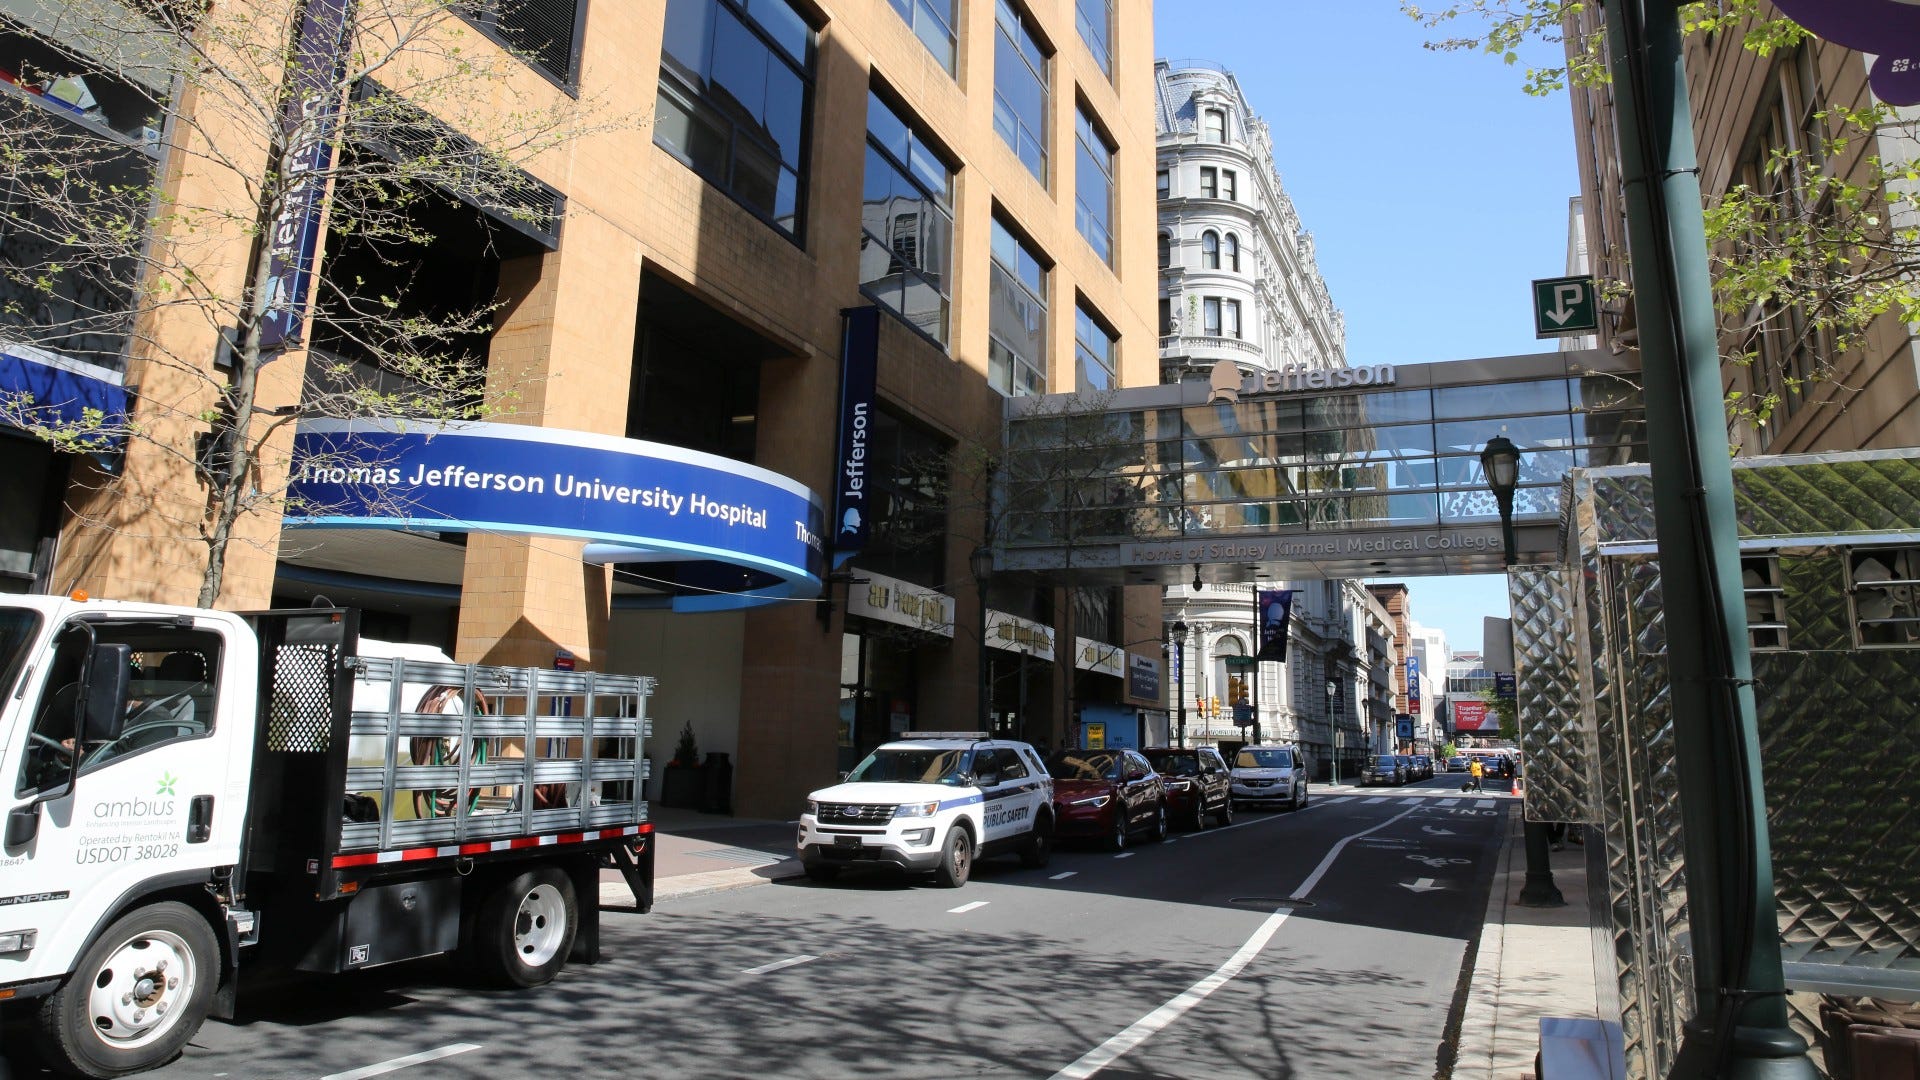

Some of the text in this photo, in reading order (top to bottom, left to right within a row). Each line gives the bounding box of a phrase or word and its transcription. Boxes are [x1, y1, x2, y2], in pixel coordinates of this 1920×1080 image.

[1247, 363, 1396, 394] Jefferson
[845, 402, 868, 500] Jefferson
[301, 462, 767, 530] Thomas Jefferson University Hospital
[1131, 533, 1499, 562] Home of Sidney Kimmel Medical College
[1408, 658, 1419, 698] PARK
[94, 797, 174, 818] ambius
[984, 805, 1029, 828] PUBLIC SAFETY
[80, 831, 180, 846] Operated by Rentokil NA
[76, 844, 179, 864] USDOT 38028
[13, 892, 51, 903] NPR
